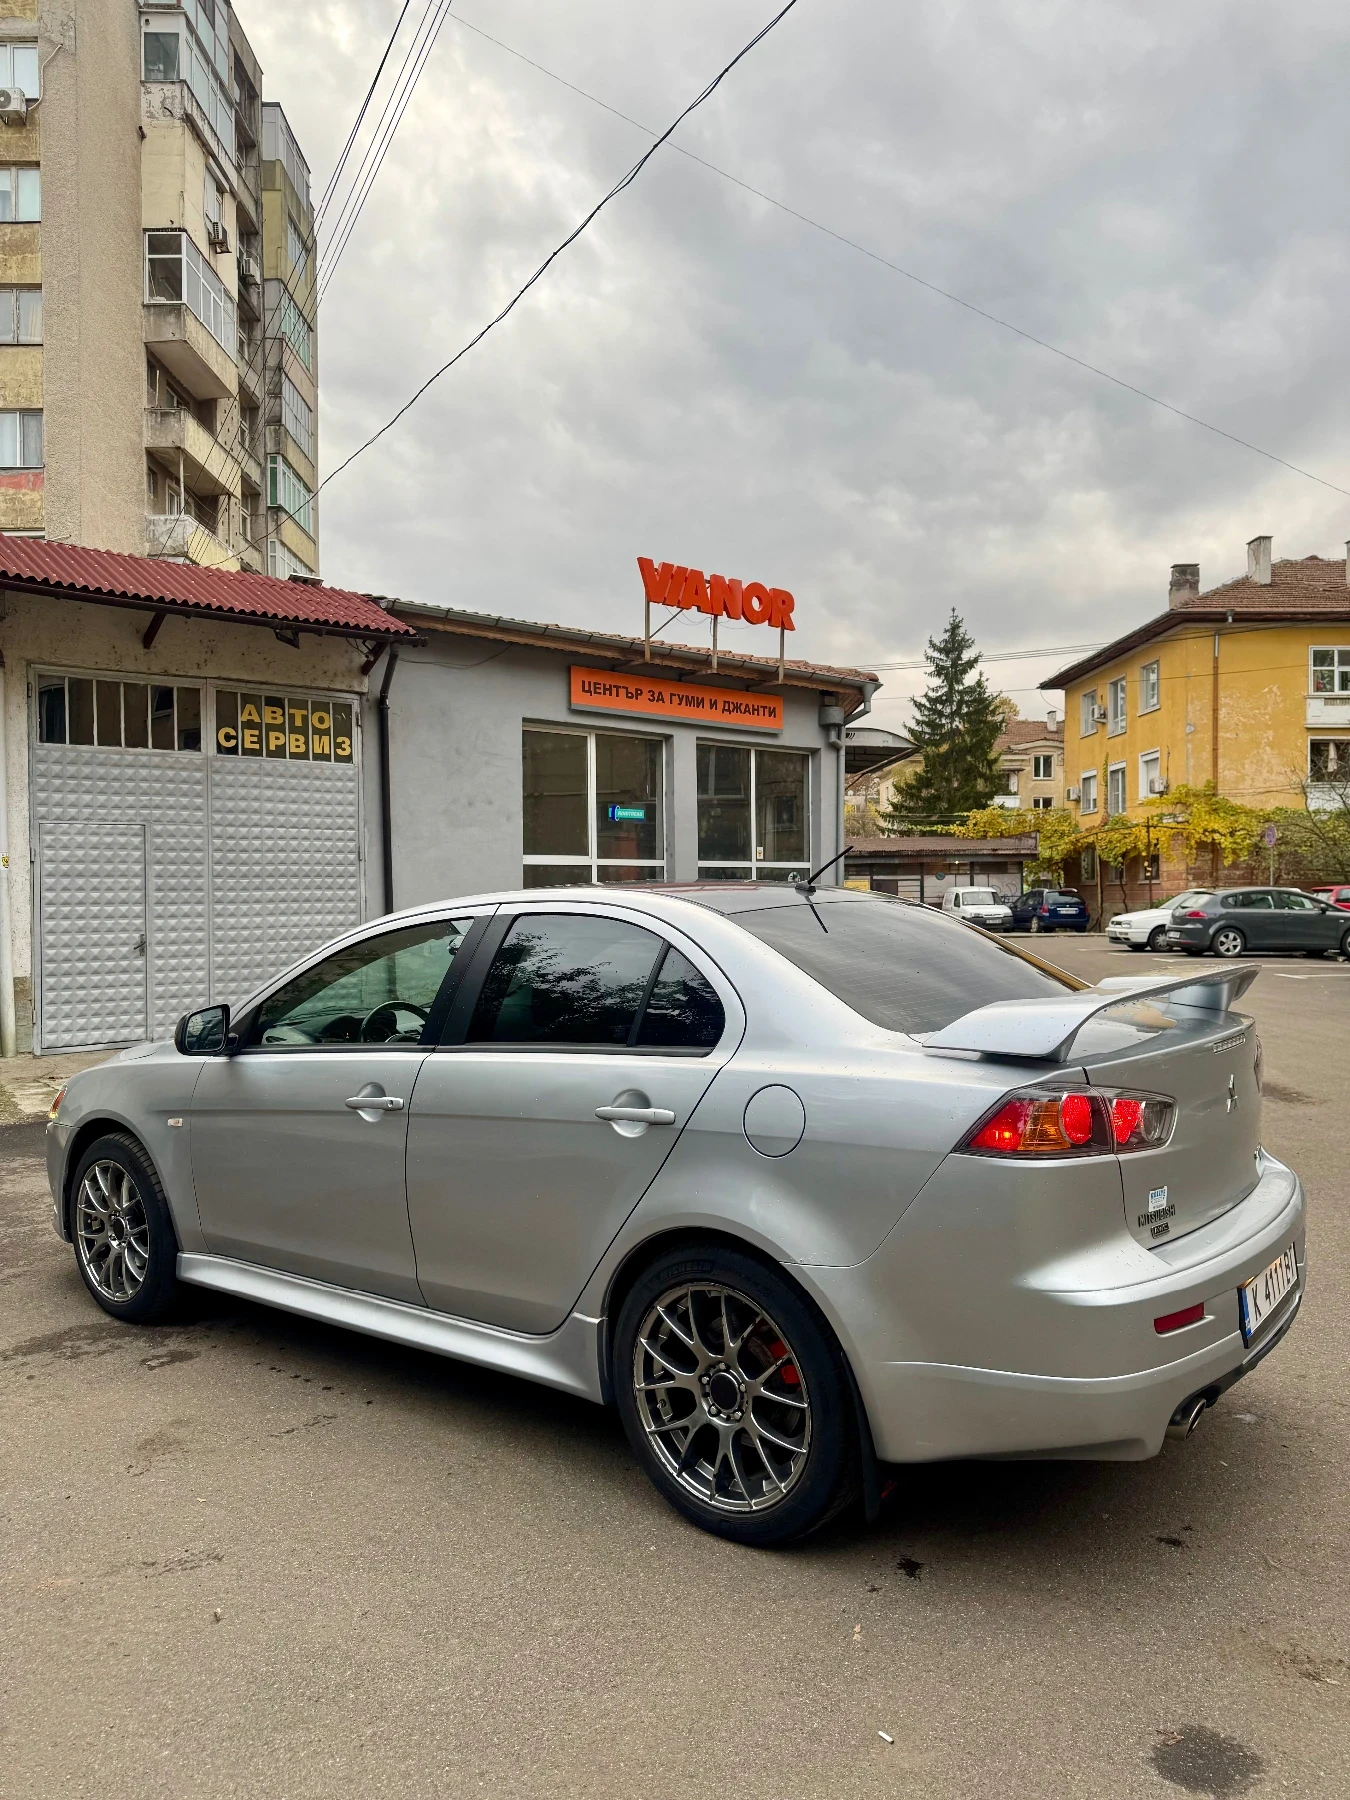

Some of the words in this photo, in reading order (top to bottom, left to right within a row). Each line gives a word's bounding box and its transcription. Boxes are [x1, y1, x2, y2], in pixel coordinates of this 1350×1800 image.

[637, 557, 795, 631] VIANOR
[240, 703, 331, 730] АВТО
[581, 680, 643, 701] ЦЕНТЪР
[647, 689, 665, 704] ЗА
[669, 692, 705, 710] ГУМИ
[709, 697, 718, 711] И
[722, 700, 777, 719] ДЖАНТИ
[217, 726, 352, 756] СЕРВИЗ
